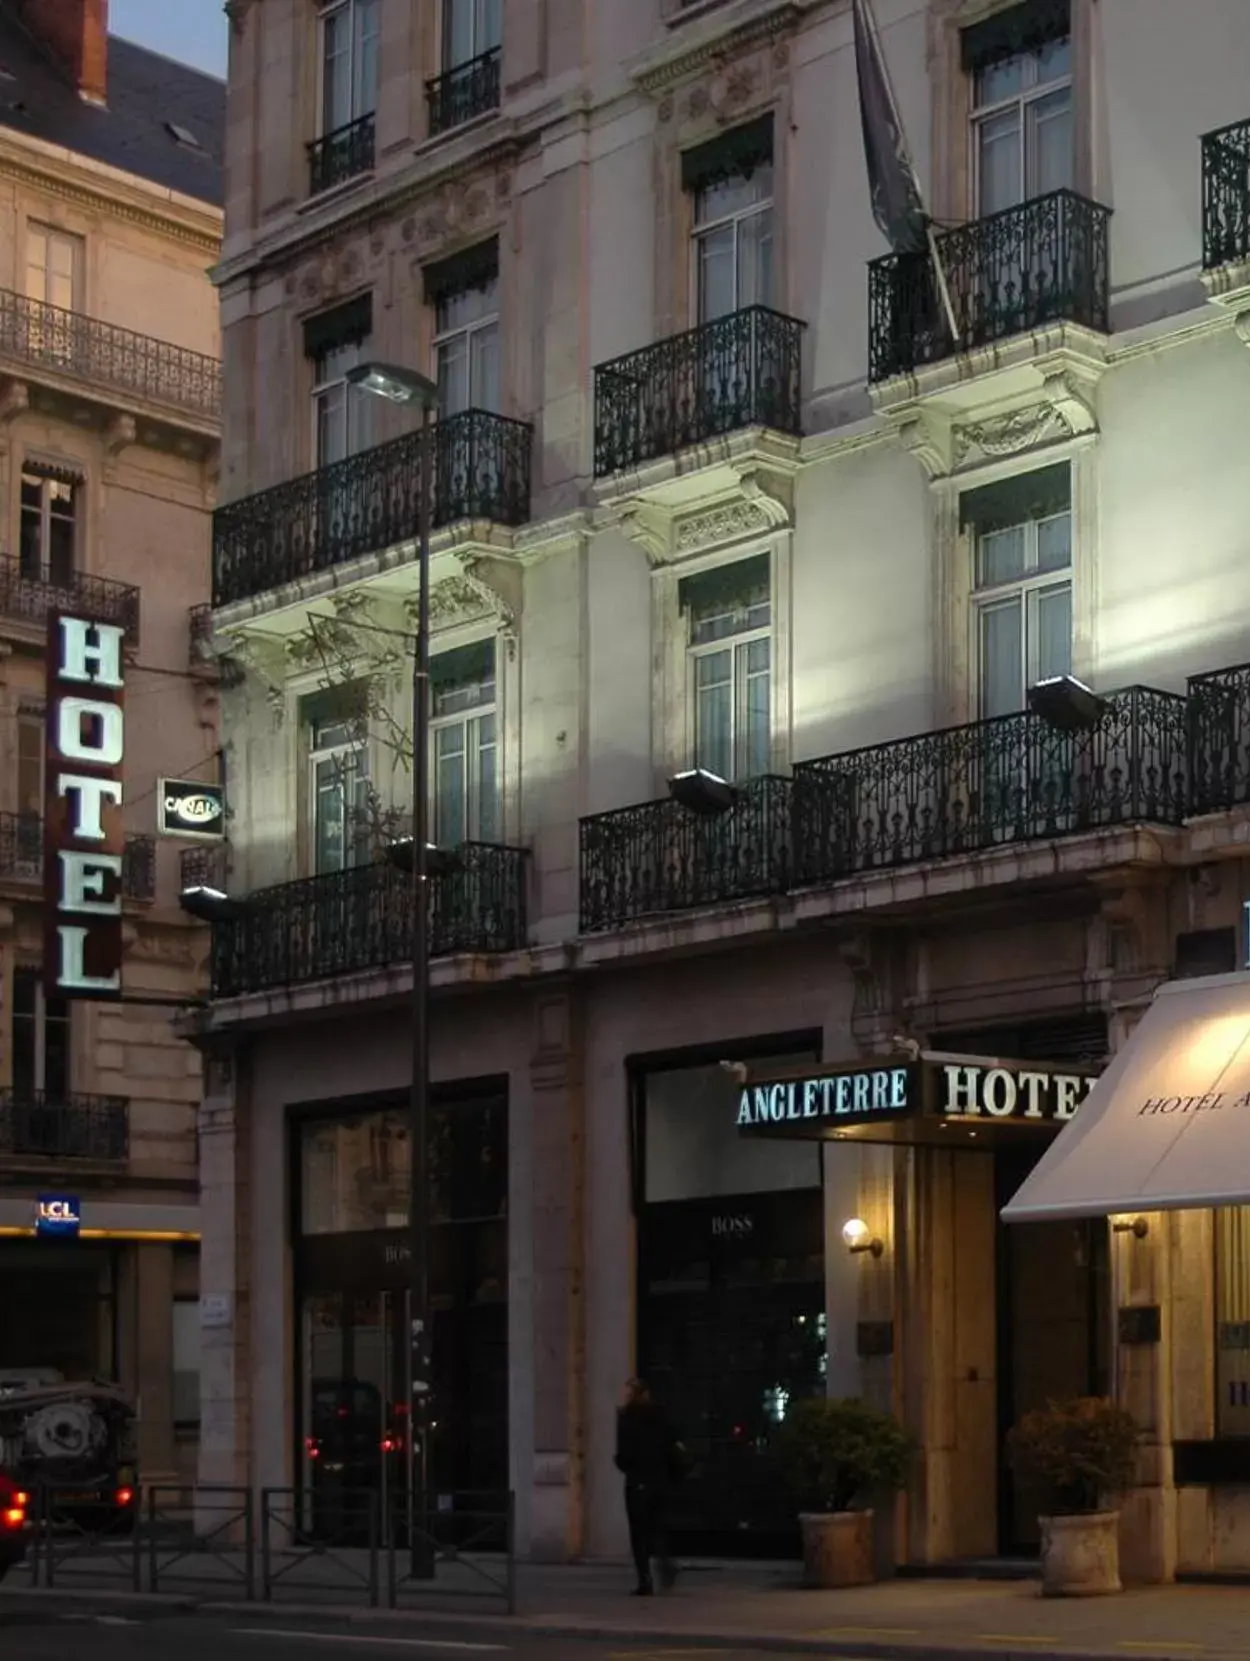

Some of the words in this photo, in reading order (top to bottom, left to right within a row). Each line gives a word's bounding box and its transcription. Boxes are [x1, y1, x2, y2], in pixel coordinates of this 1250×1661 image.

[57, 616, 125, 989] HOTEL
[735, 1069, 907, 1125] ANGLETERRE
[944, 1066, 1100, 1120] HOTE
[1137, 1092, 1228, 1117] HOTEL
[39, 1201, 74, 1217] LCL
[712, 1214, 754, 1235] BOSS
